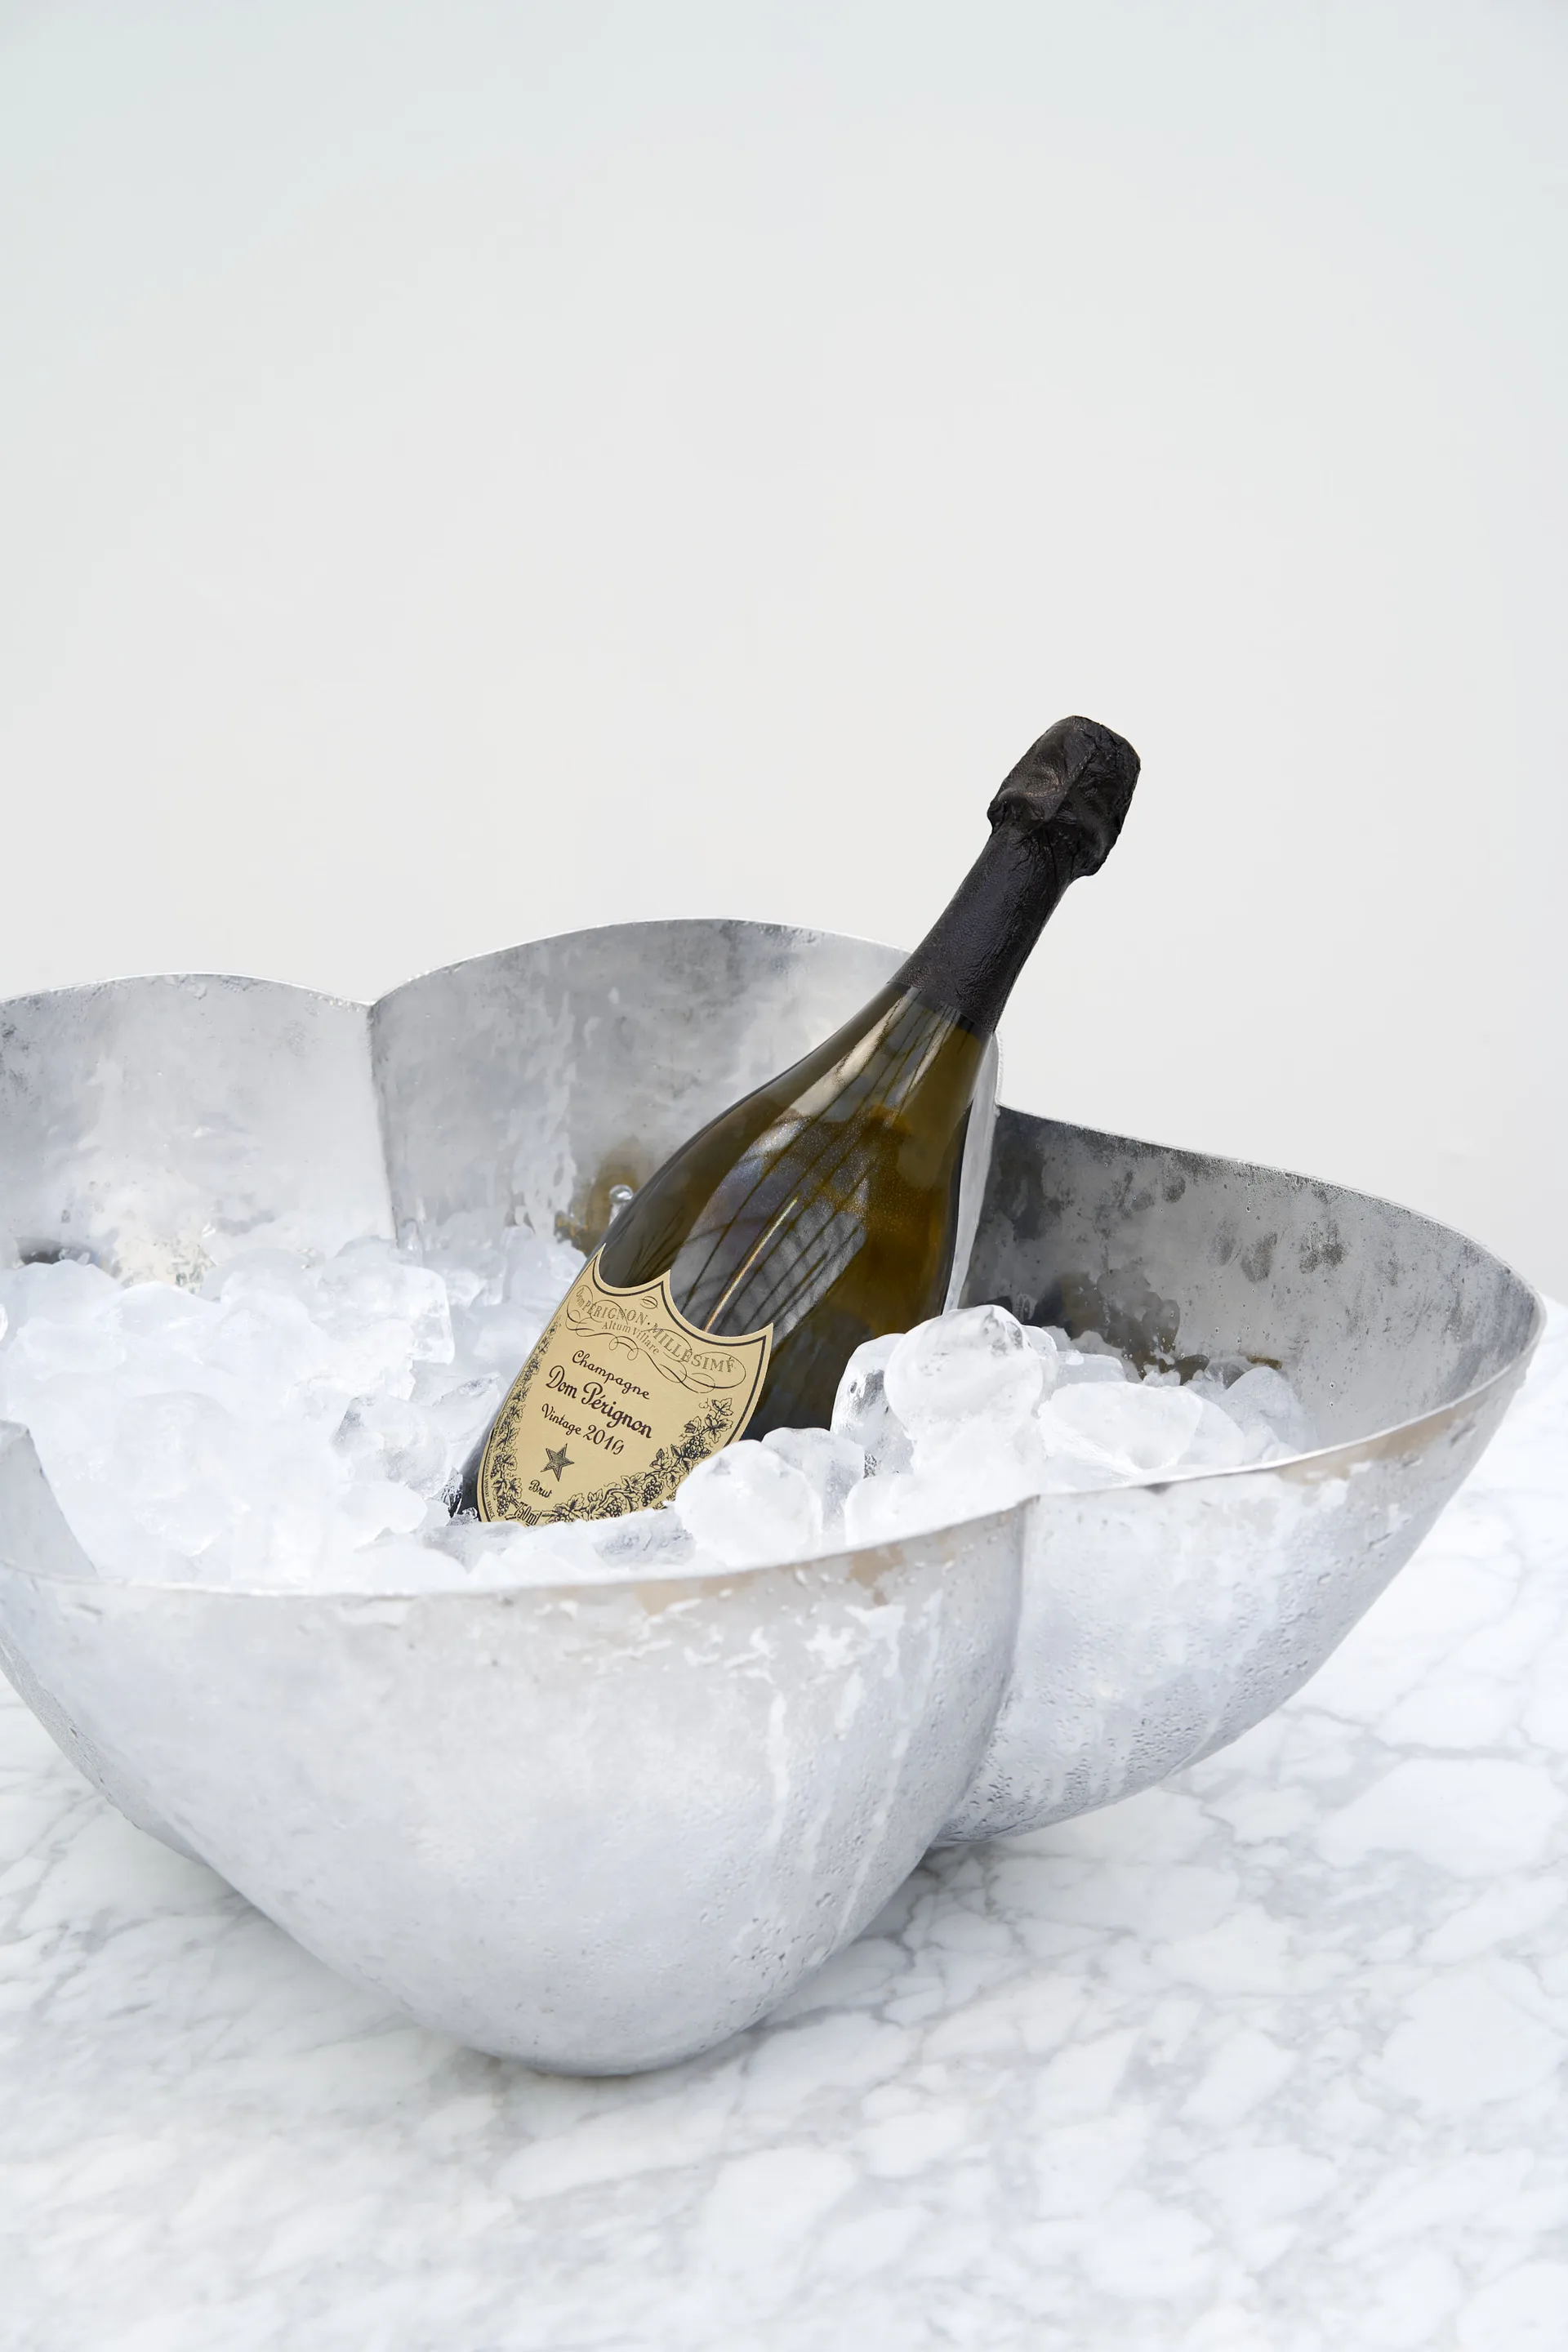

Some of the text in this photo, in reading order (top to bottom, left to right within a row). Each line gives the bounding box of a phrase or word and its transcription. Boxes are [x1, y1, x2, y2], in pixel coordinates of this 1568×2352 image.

[601, 1321, 660, 1356] Altum Villare
[572, 1349, 650, 1401] Champagne
[541, 1403, 582, 1436] Vintage
[545, 1365, 653, 1439] Dom Pérignon
[528, 1479, 553, 1499] Brut
